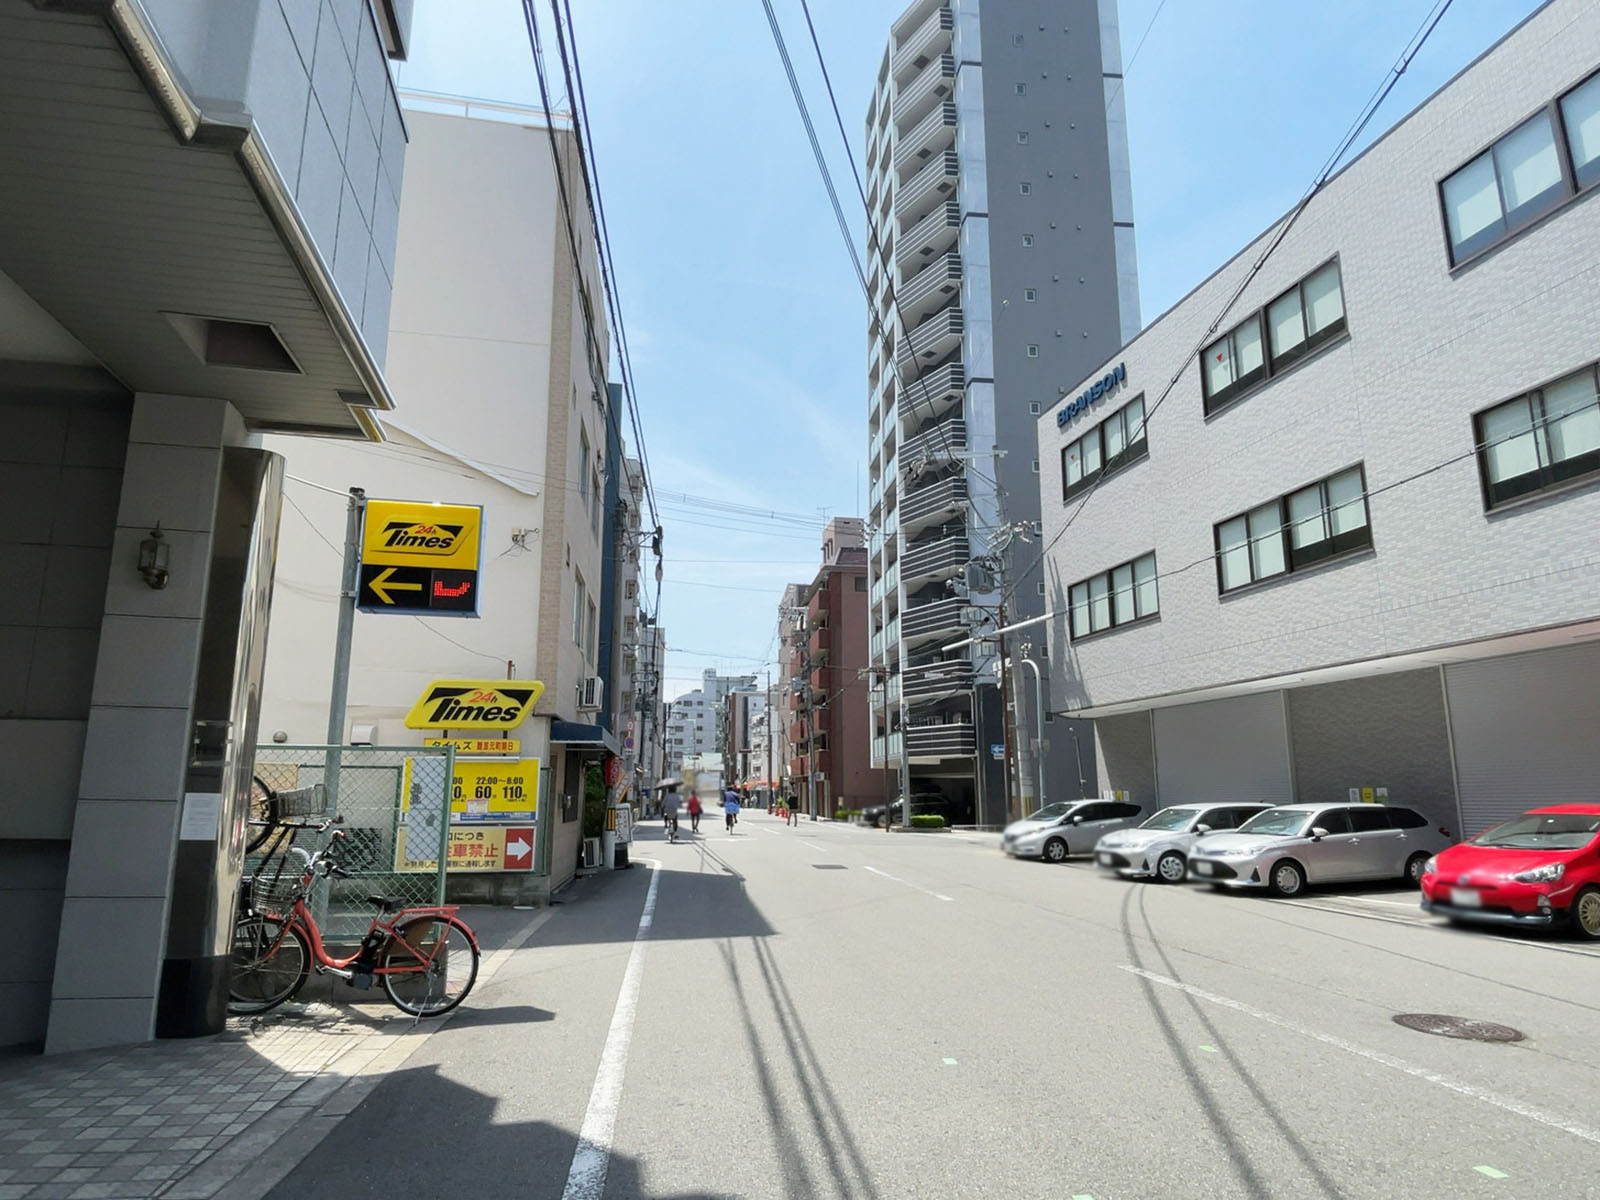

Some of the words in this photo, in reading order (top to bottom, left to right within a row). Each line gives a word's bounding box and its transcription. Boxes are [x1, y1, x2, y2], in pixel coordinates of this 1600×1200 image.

[1057, 362, 1126, 428] BRANSON
[382, 522, 457, 549] Times
[425, 688, 521, 722] Times
[469, 689, 498, 704] 24h
